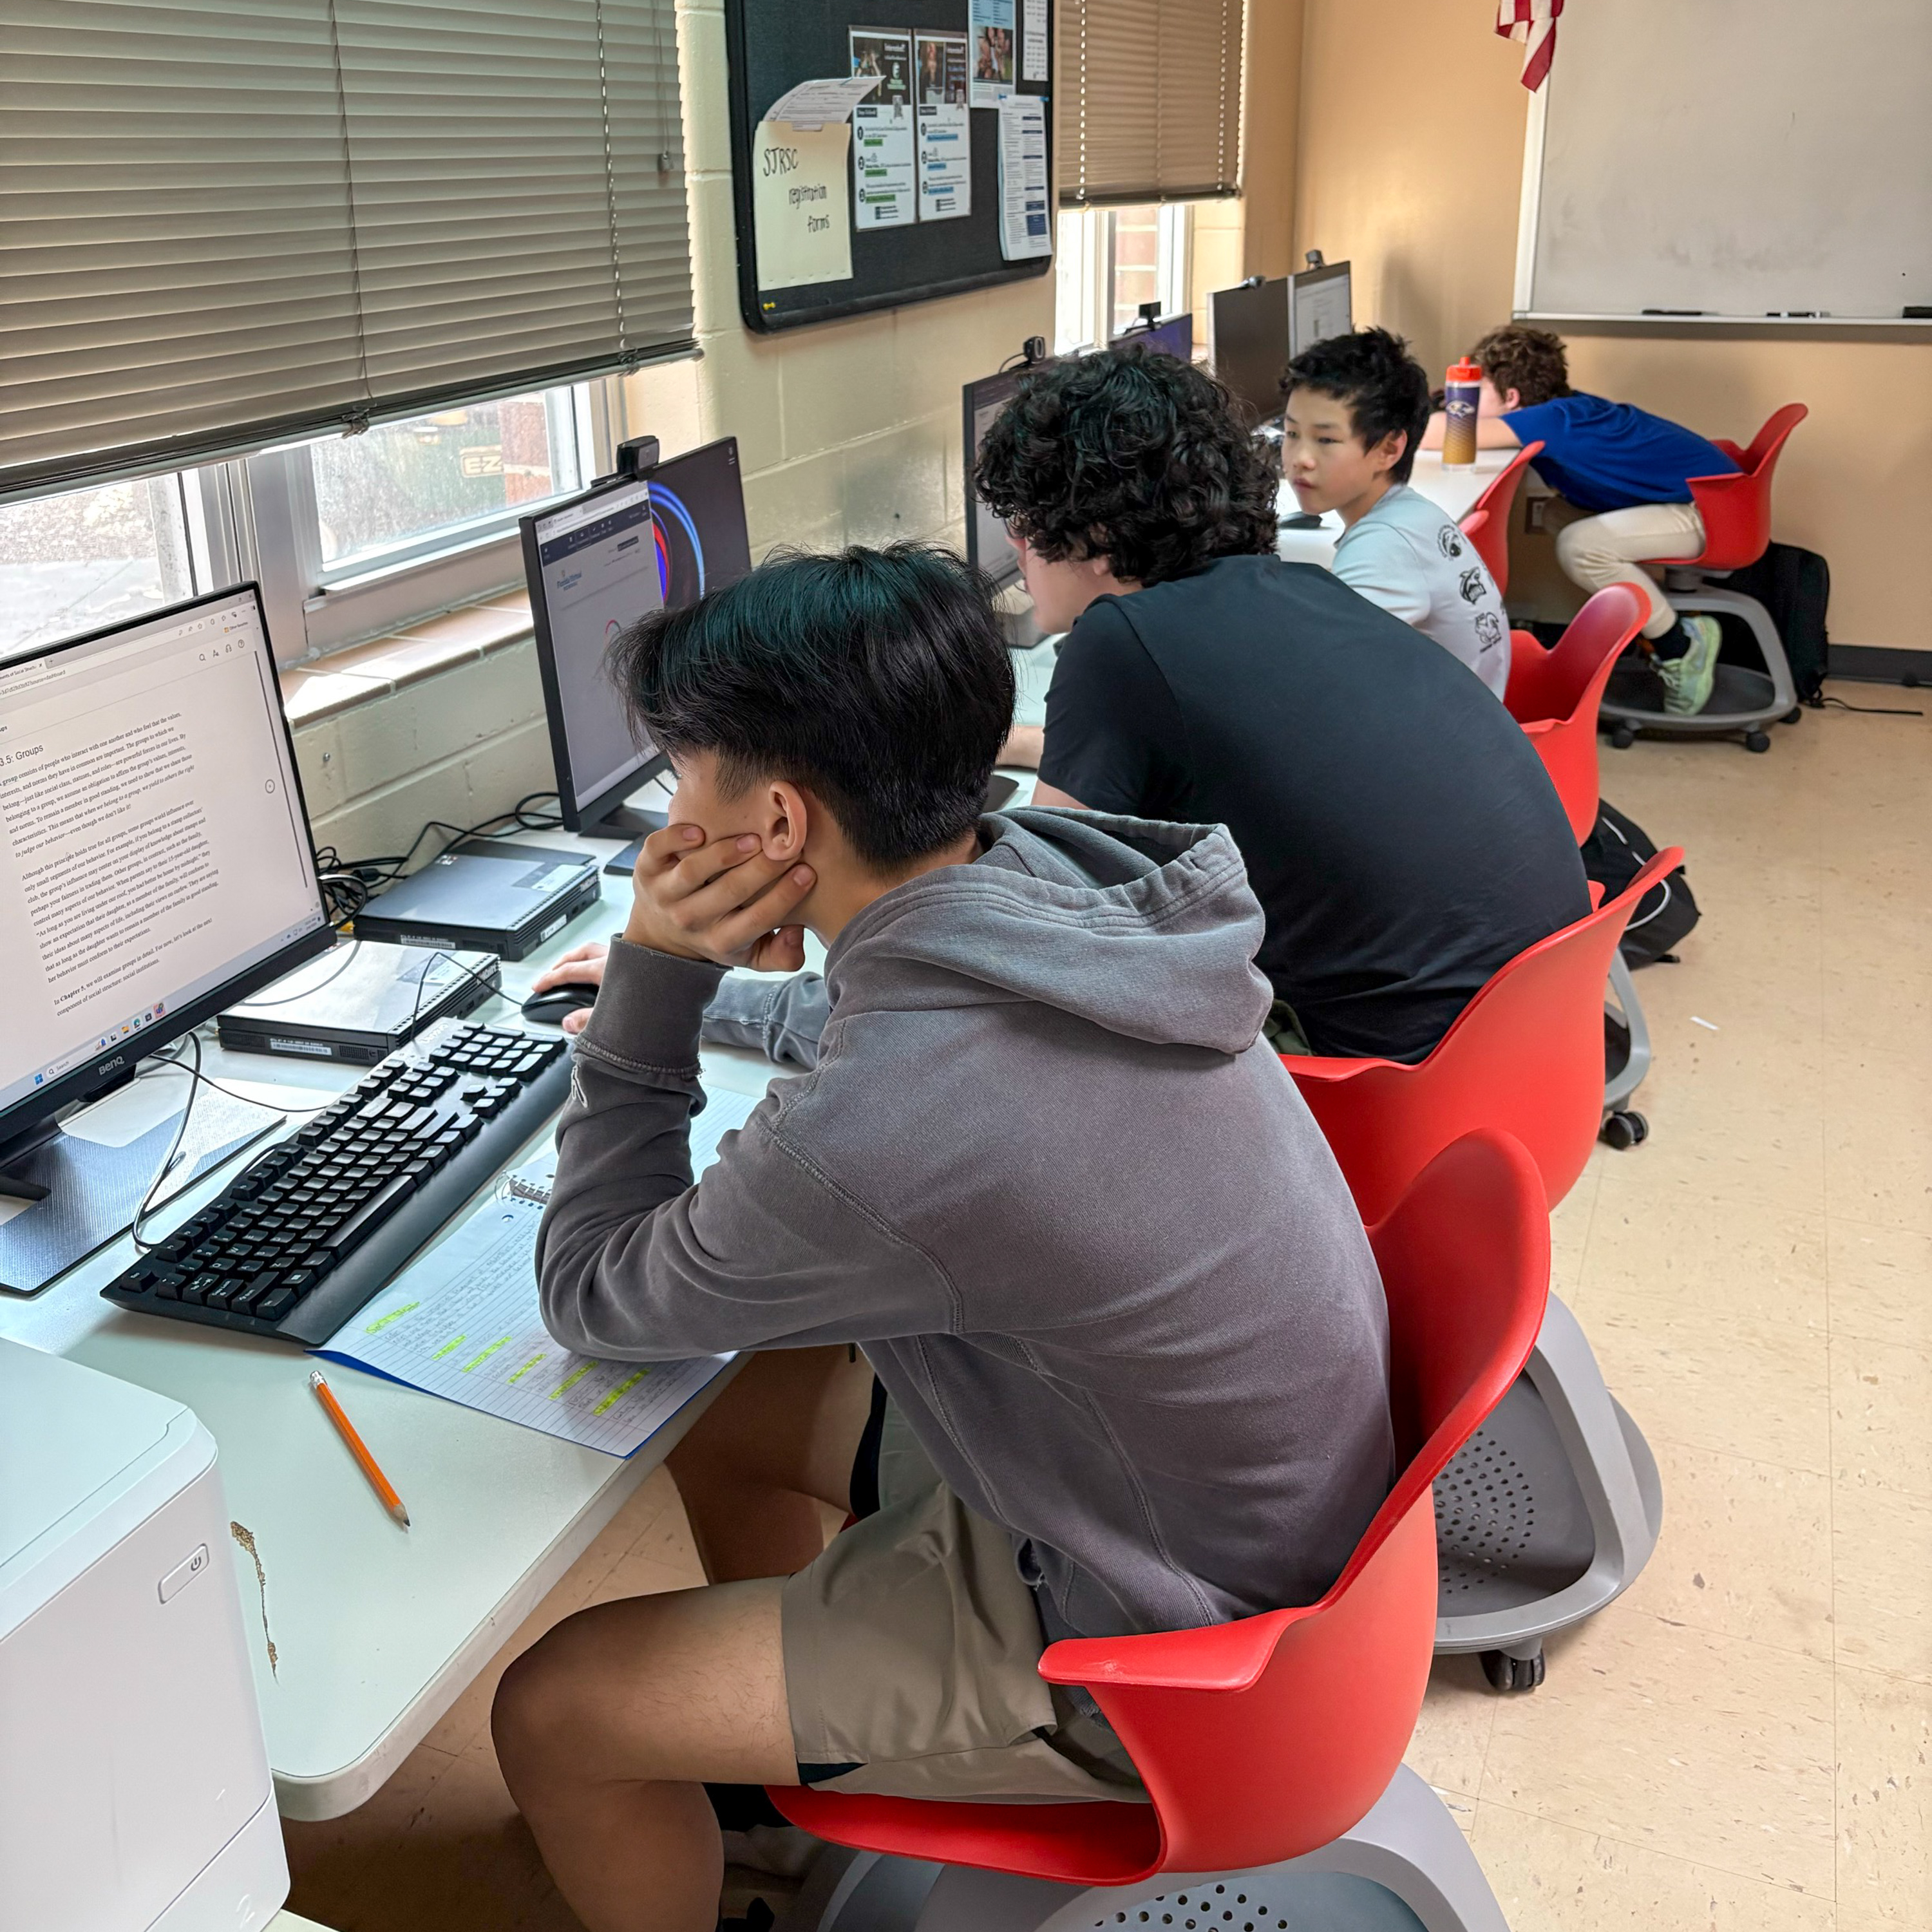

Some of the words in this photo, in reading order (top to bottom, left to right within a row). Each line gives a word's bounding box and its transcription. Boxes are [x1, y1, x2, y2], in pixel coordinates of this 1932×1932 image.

[762, 147, 799, 177] SJRSC
[808, 214, 830, 233] forms
[463, 455, 502, 475] EZ
[2, 775, 17, 786] group
[18, 768, 37, 778] consists
[43, 759, 59, 770] people
[71, 748, 88, 758] interact
[108, 734, 124, 743] another
[15, 745, 44, 760] Groups
[32, 777, 47, 786] norms
[75, 758, 95, 768] common
[135, 736, 149, 746] groups
[154, 728, 167, 737] which
[44, 784, 58, 794] social
[123, 750, 142, 763] powerful
[142, 746, 155, 754] forces
[5, 809, 30, 822] belonging
[64, 788, 80, 799] assume
[88, 777, 109, 788] obligation
[116, 769, 129, 777] affirm
[43, 810, 60, 820] remain
[64, 800, 82, 811] member
[88, 791, 100, 802] good
[128, 776, 138, 784] need
[47, 822, 59, 831] This
[59, 817, 74, 826] means
[104, 797, 118, 807] belong
[148, 779, 158, 789] yield
[164, 772, 176, 781] others
[21, 846, 35, 857] judge
[81, 819, 97, 829] though
[55, 1061, 70, 1072] Search
[98, 1055, 125, 1076] BenQ
